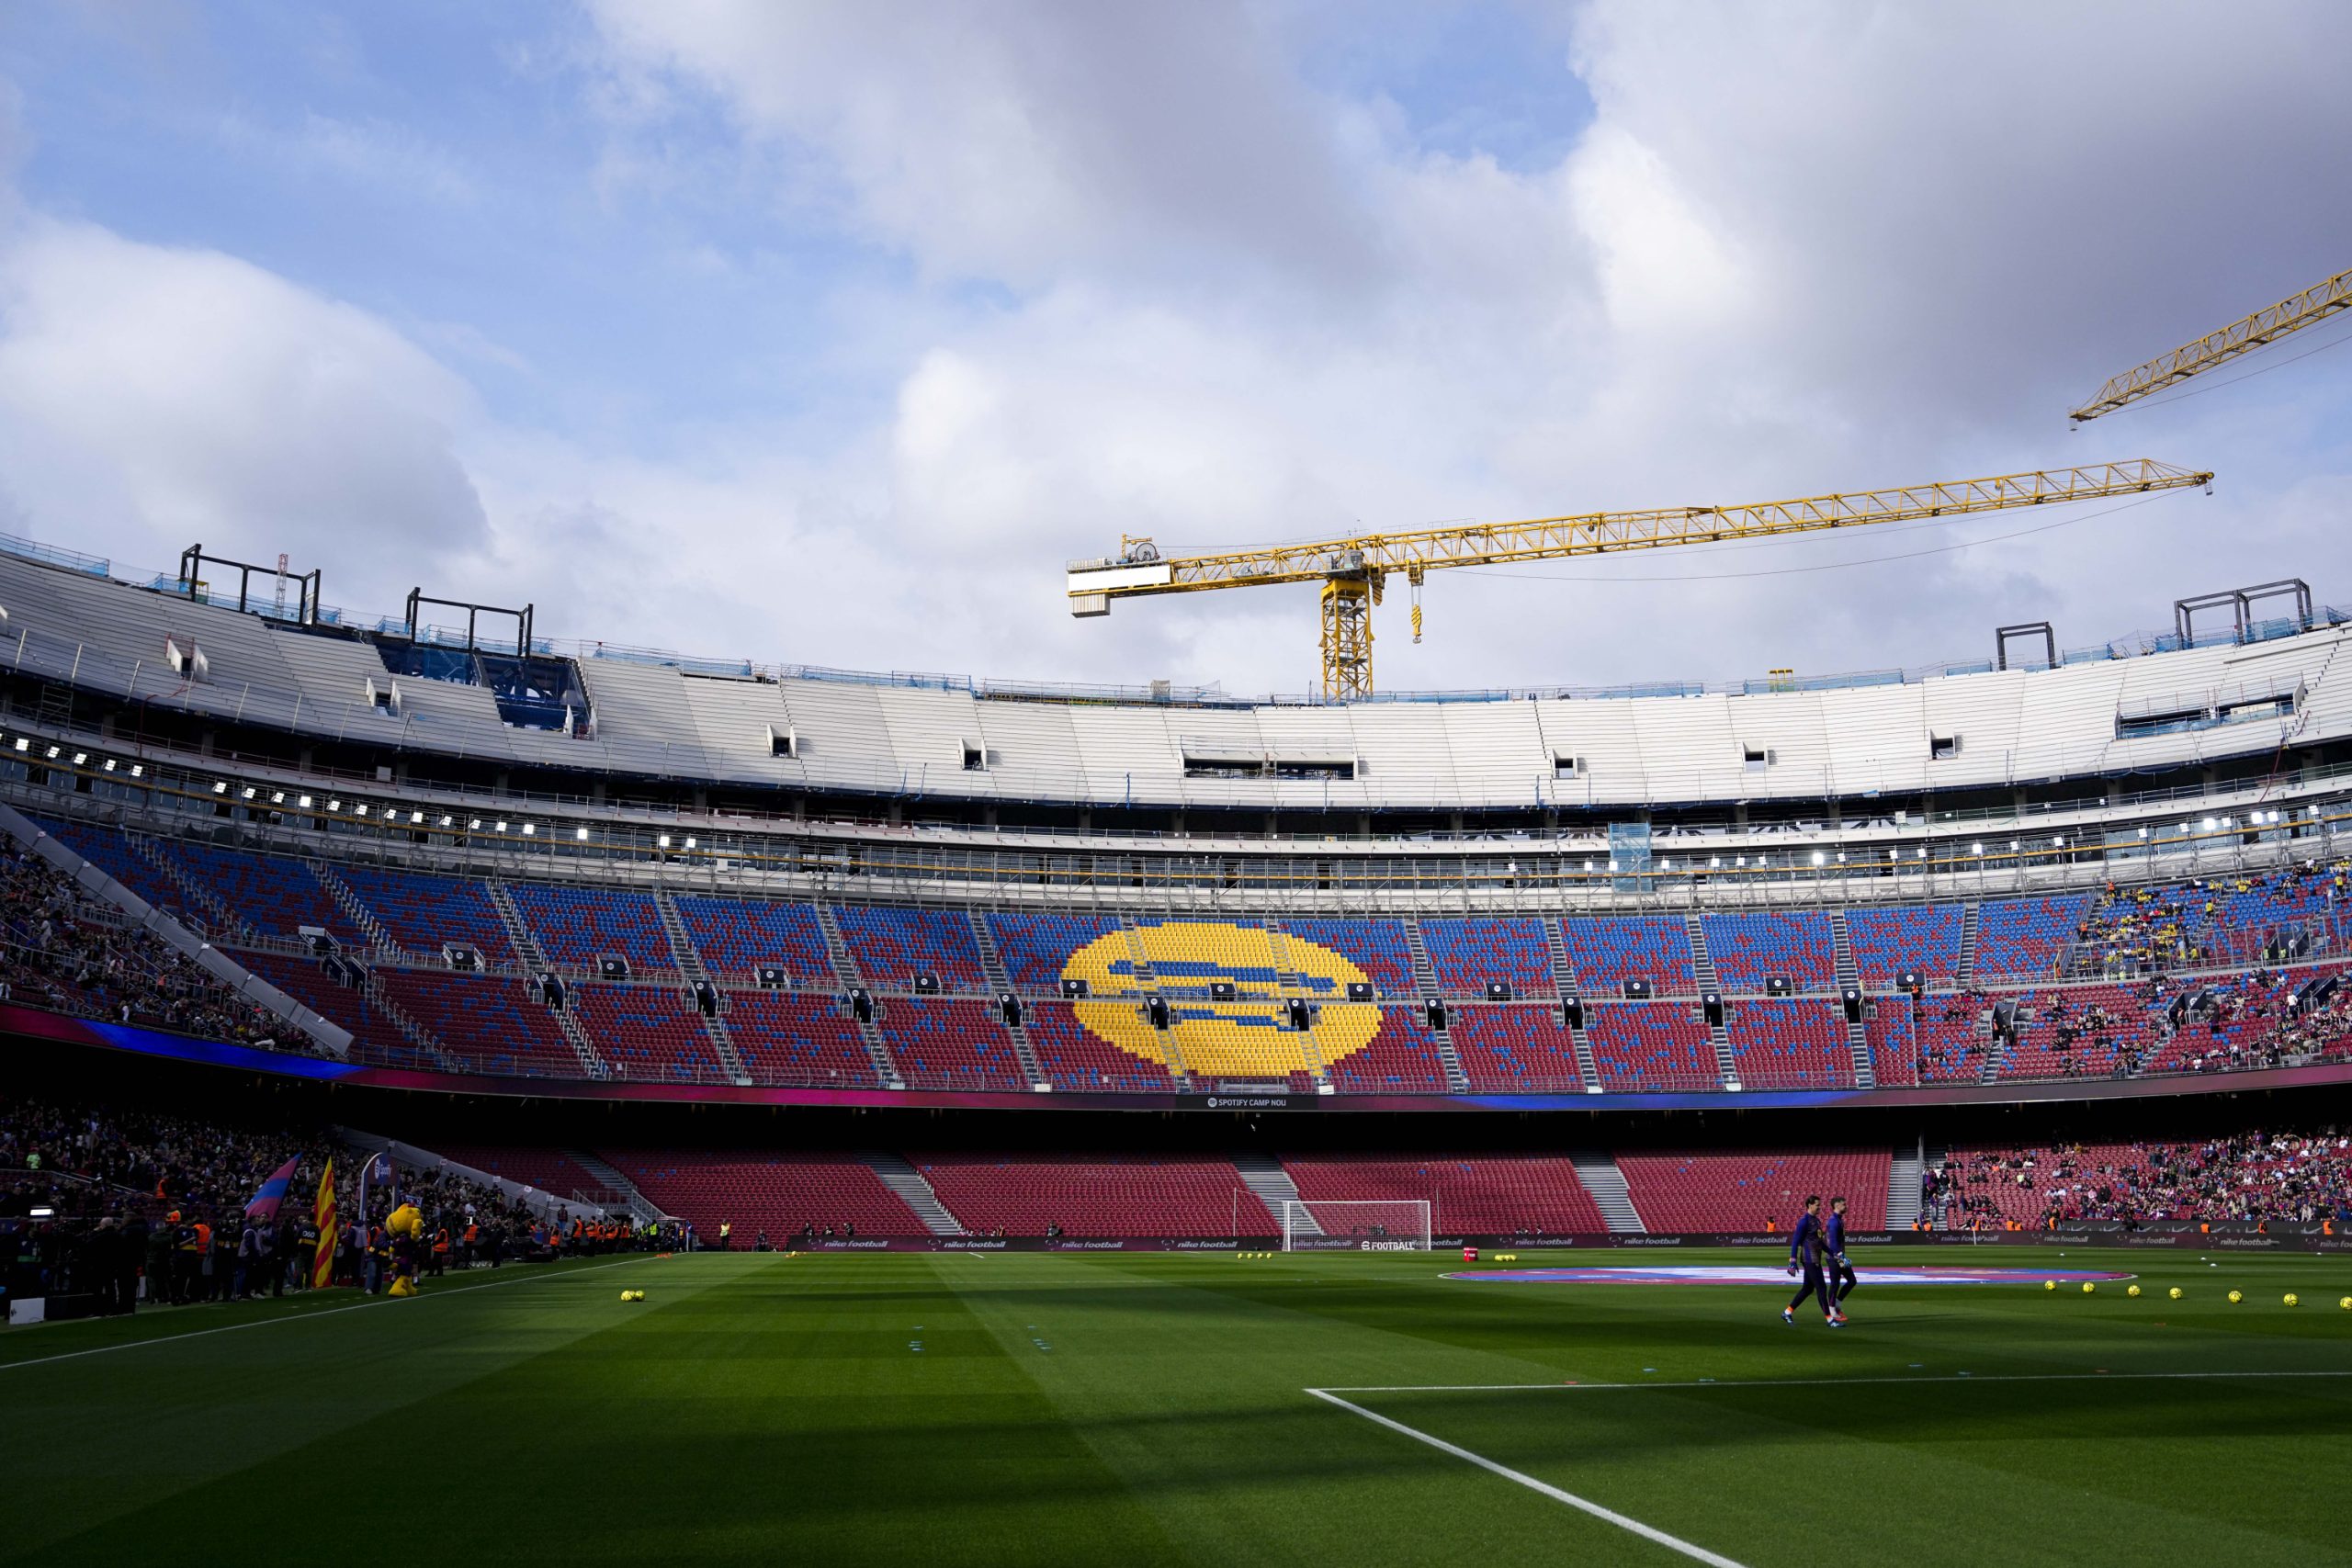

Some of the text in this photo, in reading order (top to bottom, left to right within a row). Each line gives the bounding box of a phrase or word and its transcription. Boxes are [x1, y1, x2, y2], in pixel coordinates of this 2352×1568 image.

[1218, 1099, 1286, 1107] SPOTIFY CAMP NOU
[1858, 1235, 1893, 1243] football
[2061, 1235, 2089, 1243] football
[2146, 1236, 2177, 1245] football
[1083, 1240, 1124, 1248] football
